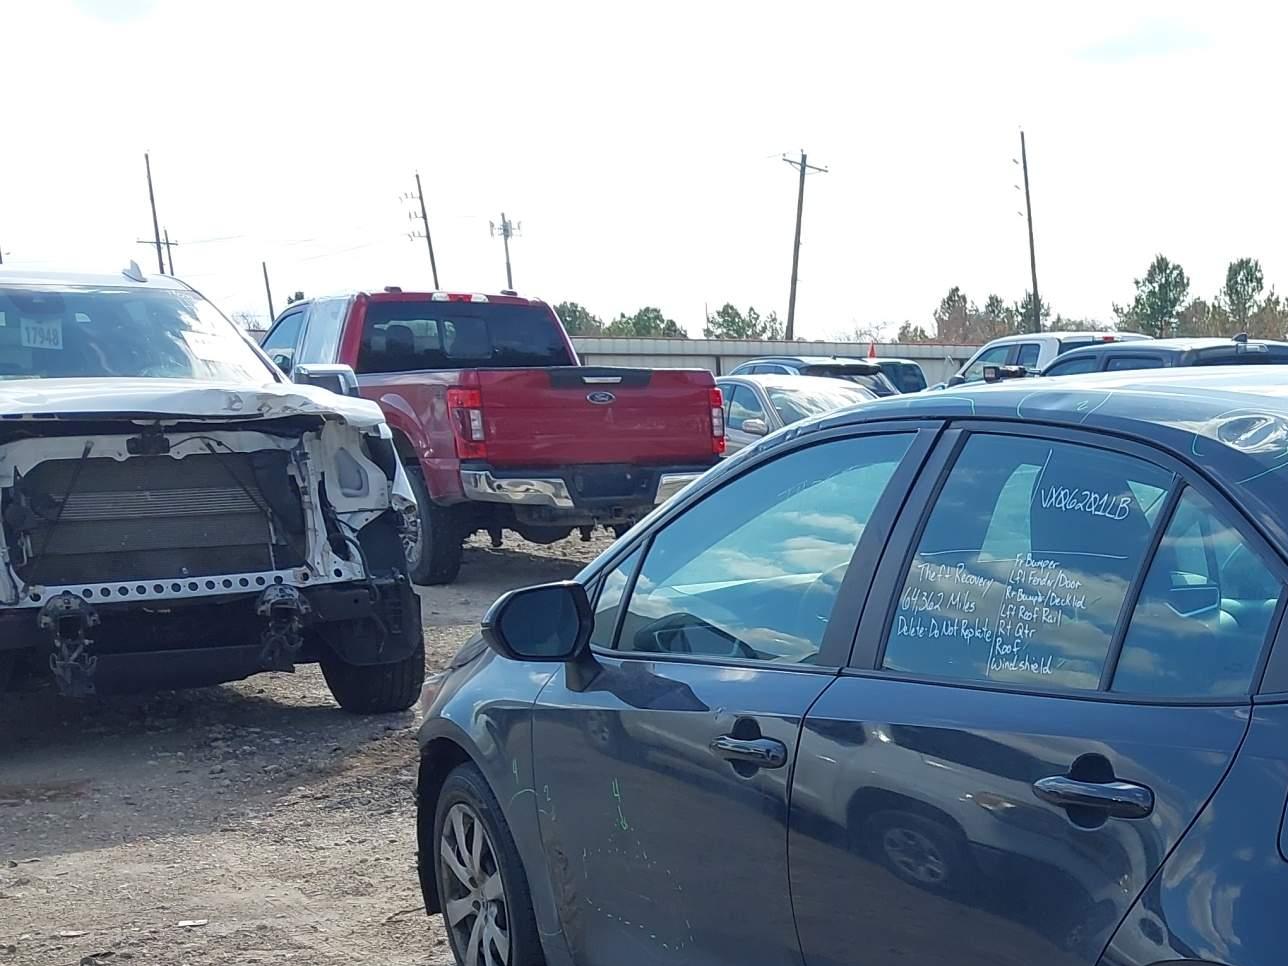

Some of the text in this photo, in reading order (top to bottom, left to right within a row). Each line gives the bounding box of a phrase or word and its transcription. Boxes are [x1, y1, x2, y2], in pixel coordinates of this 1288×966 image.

[1025, 552, 1060, 573] Bumper
[917, 562, 994, 598] Theft Recovery
[901, 586, 976, 615] 64,362 Miles
[1000, 603, 1063, 628] Lft Roof Rail
[940, 618, 959, 638] Not
[998, 619, 1037, 639] Rt Qtr
[995, 637, 1022, 655] Roof
[990, 655, 1053, 674] Windshield
